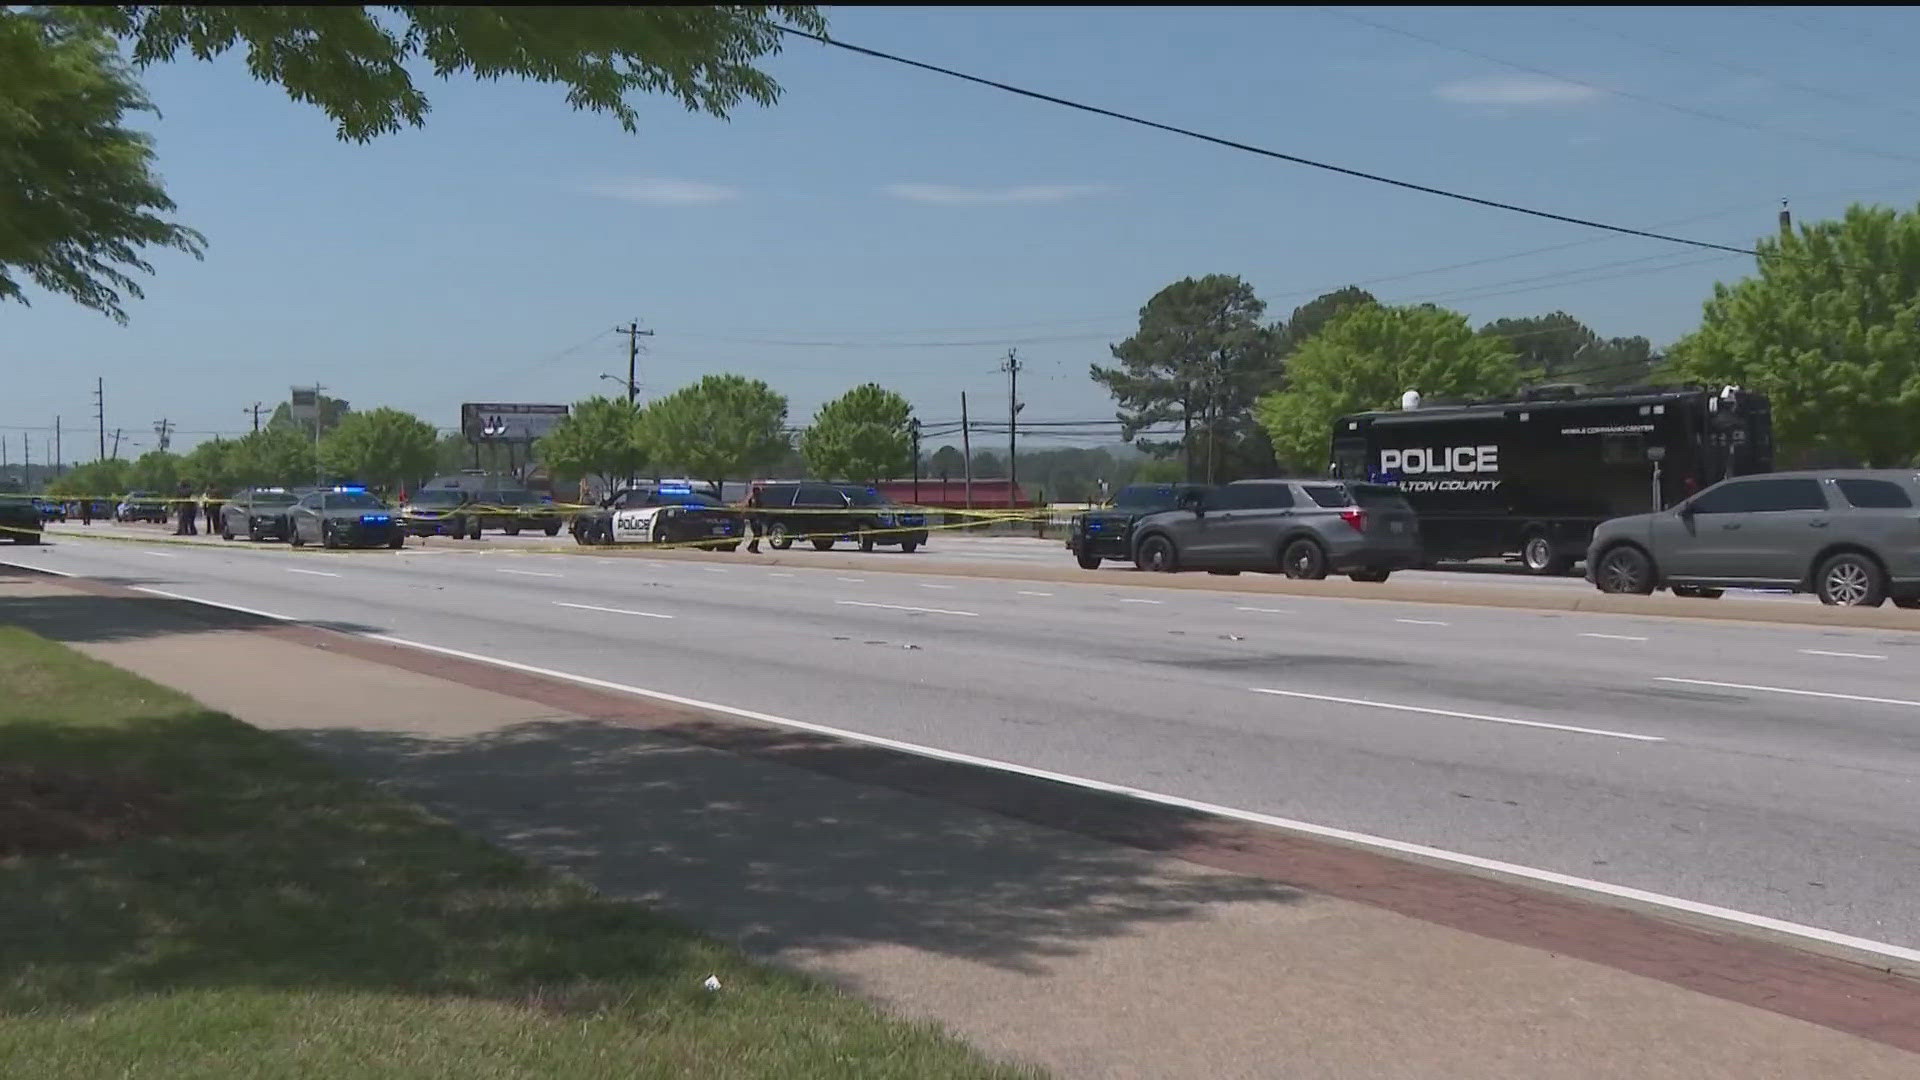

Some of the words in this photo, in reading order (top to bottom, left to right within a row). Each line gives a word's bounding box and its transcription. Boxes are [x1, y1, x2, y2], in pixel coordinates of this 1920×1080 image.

[1381, 445, 1498, 474] POLICE
[1439, 480, 1501, 491] COUNTY
[618, 519, 650, 530] POLICE
